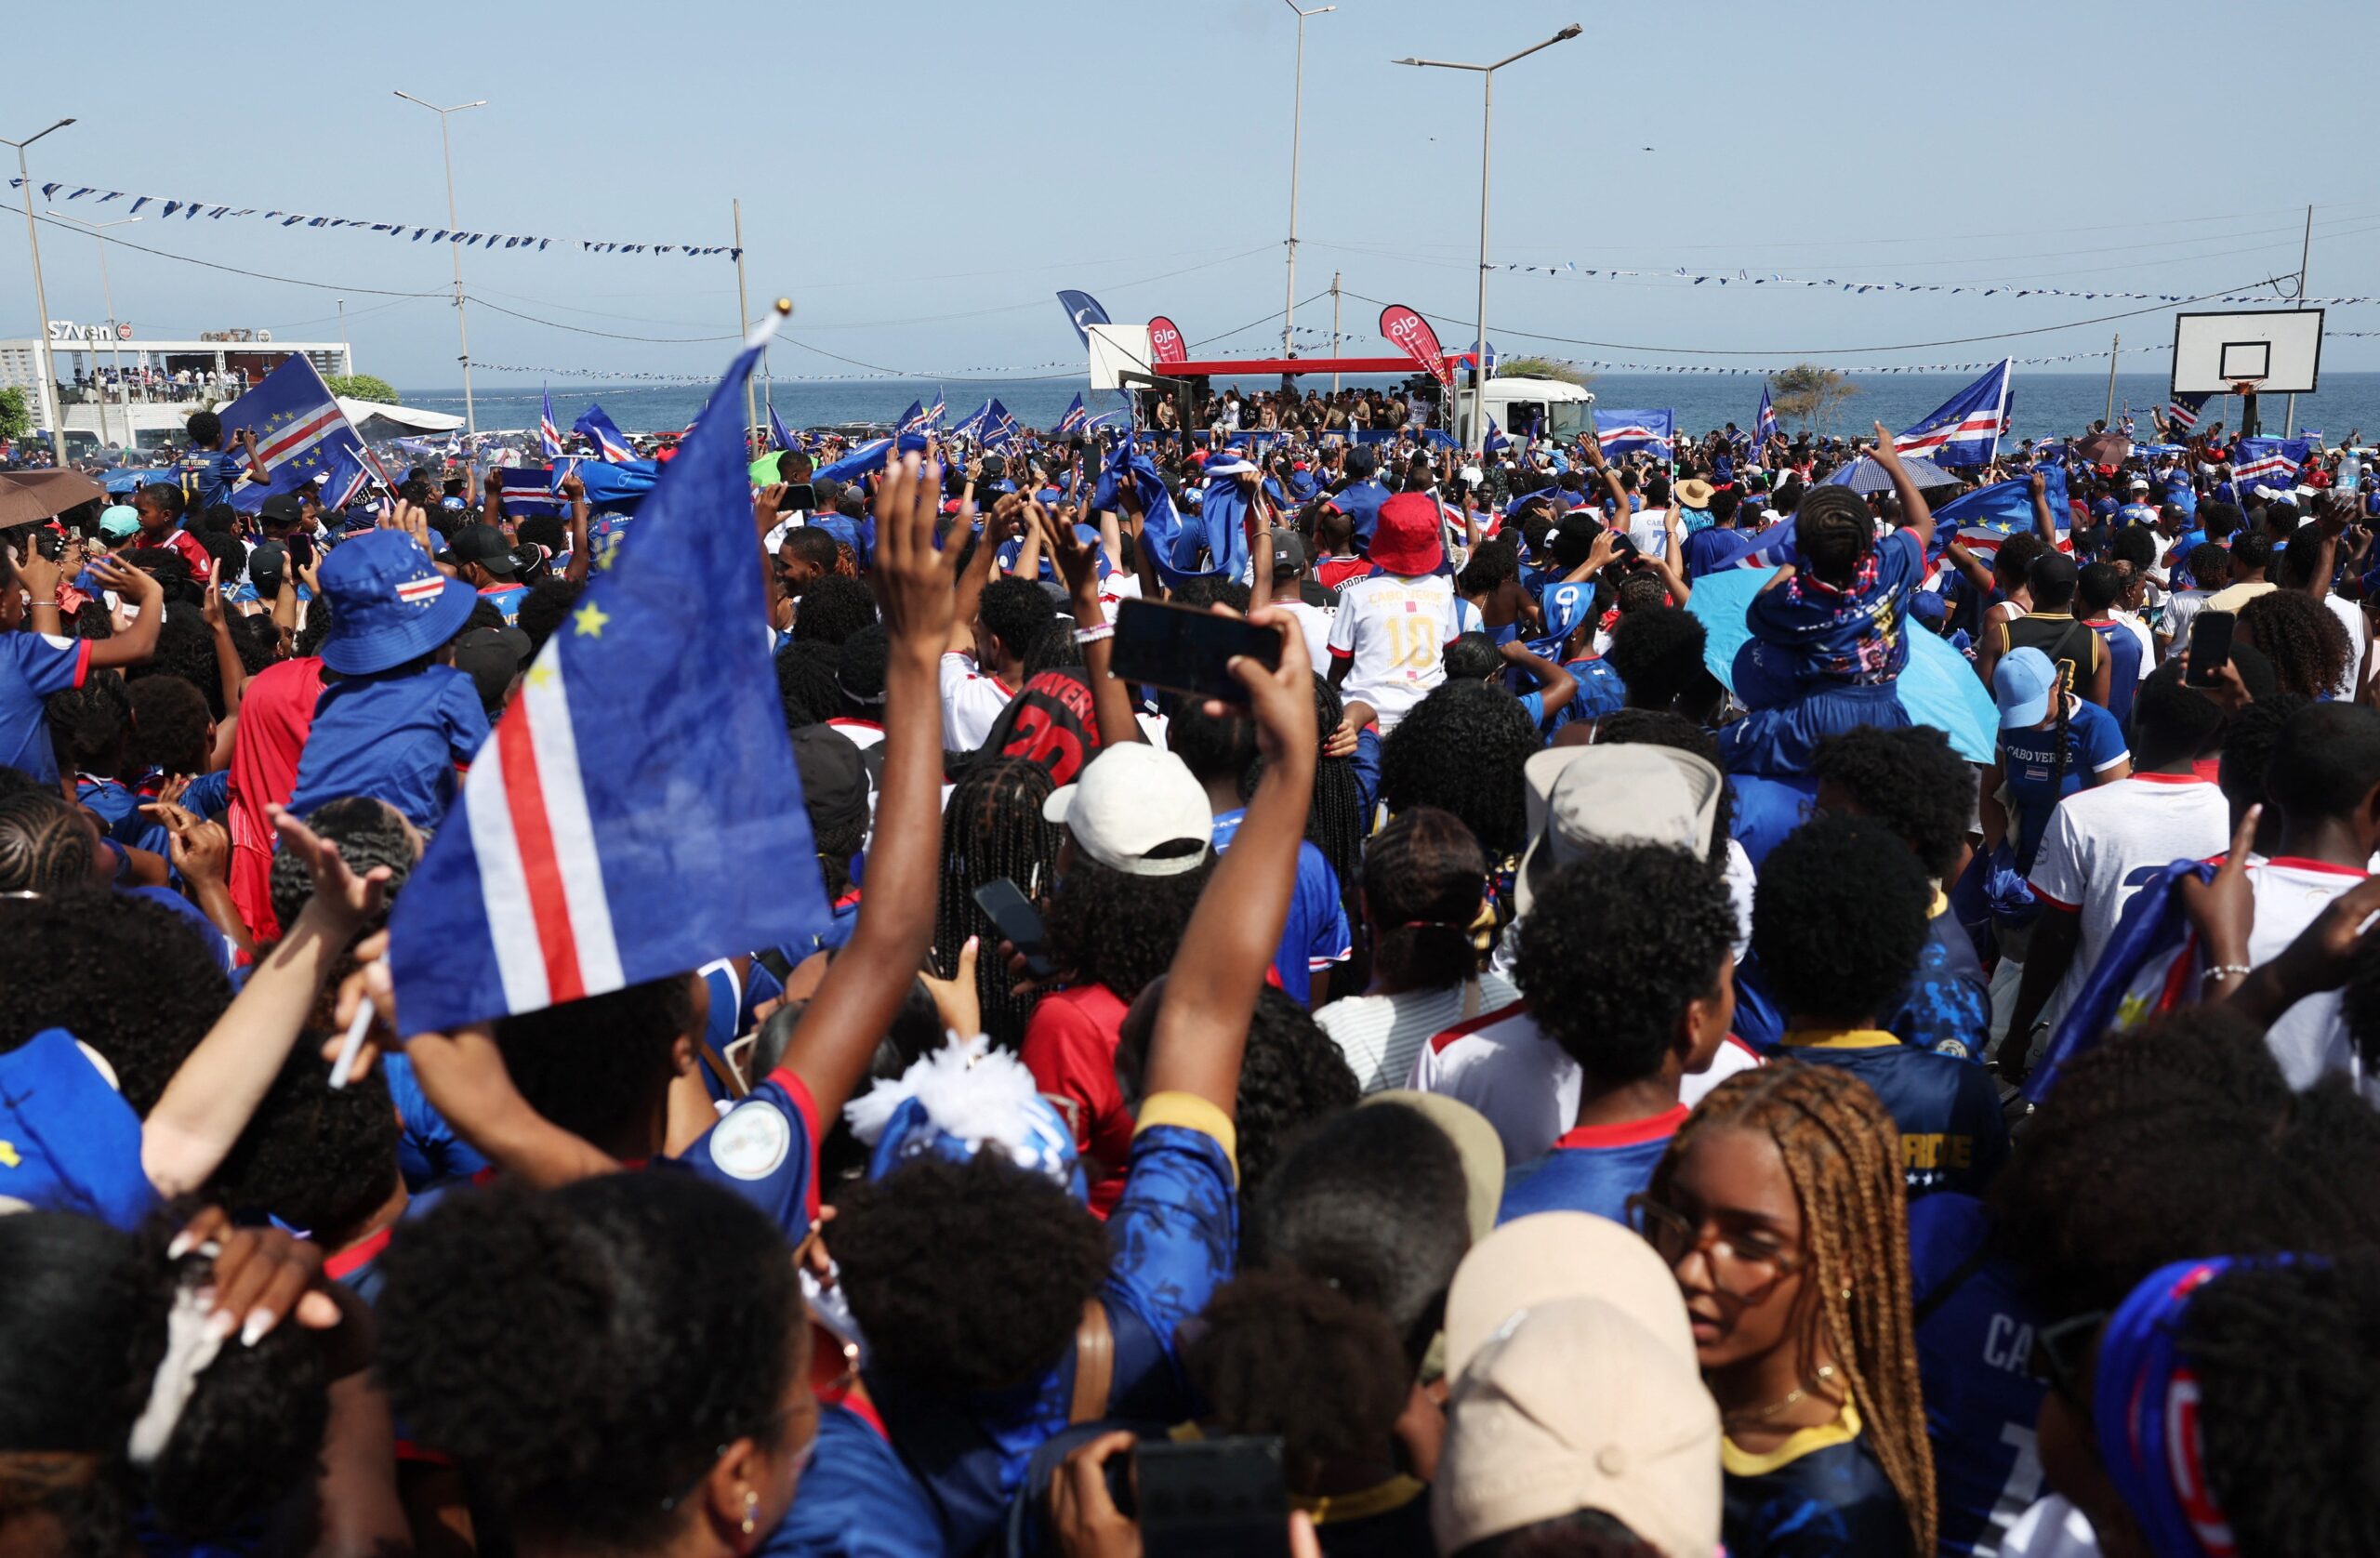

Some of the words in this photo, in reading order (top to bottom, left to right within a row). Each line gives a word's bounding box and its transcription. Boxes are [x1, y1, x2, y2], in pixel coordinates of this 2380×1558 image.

[47, 320, 112, 340] S7ven
[180, 471, 199, 492] 11
[1652, 529, 1667, 558] 7
[1368, 592, 1404, 604] CABO
[1408, 589, 1446, 602] VERDE
[1383, 615, 1435, 667] 10
[1004, 704, 1083, 787] 20
[2006, 746, 2033, 762] CABO
[2034, 751, 2074, 763] VERE
[1901, 1133, 1973, 1169] RDE
